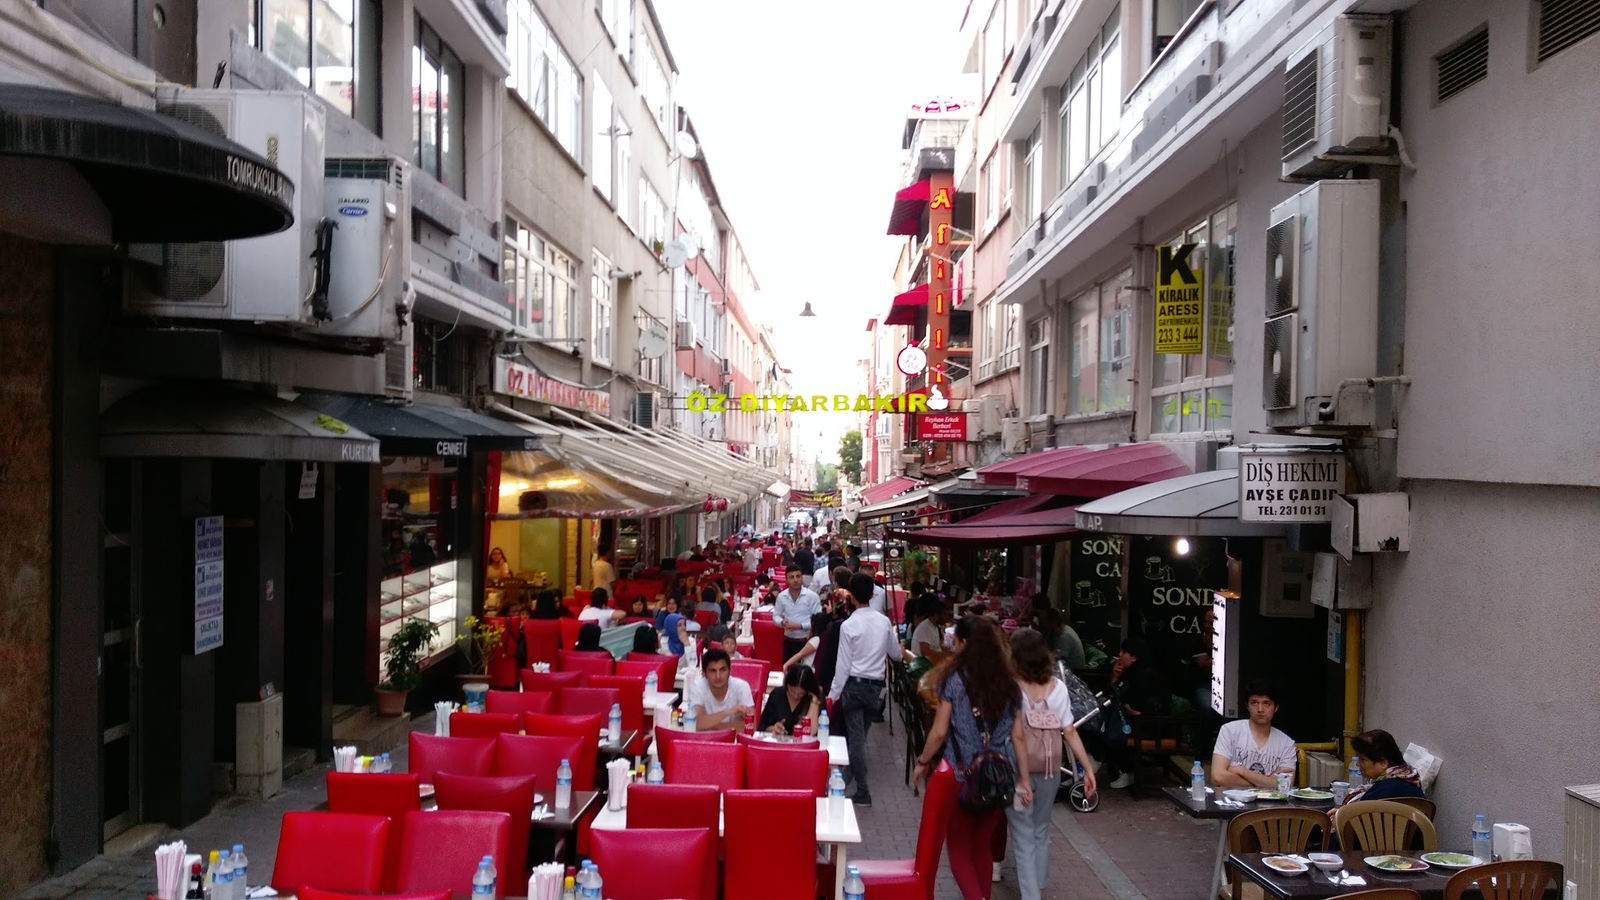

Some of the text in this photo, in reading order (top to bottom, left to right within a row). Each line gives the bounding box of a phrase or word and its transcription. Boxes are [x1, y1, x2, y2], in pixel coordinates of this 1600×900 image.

[342, 207, 364, 215] Carrier
[1160, 244, 1199, 286] K
[1159, 287, 1200, 303] KİRALIK
[1159, 304, 1199, 317] ARESS
[1158, 327, 1199, 343] 233 3 444
[686, 389, 929, 413] ÖZ DİYARBAKIR
[1246, 457, 1338, 487] DİŞ HEKİMİ
[1245, 489, 1284, 503] AYŞE
[1258, 506, 1326, 516] TEL: 231 01 31
[1082, 540, 1124, 556] SON
